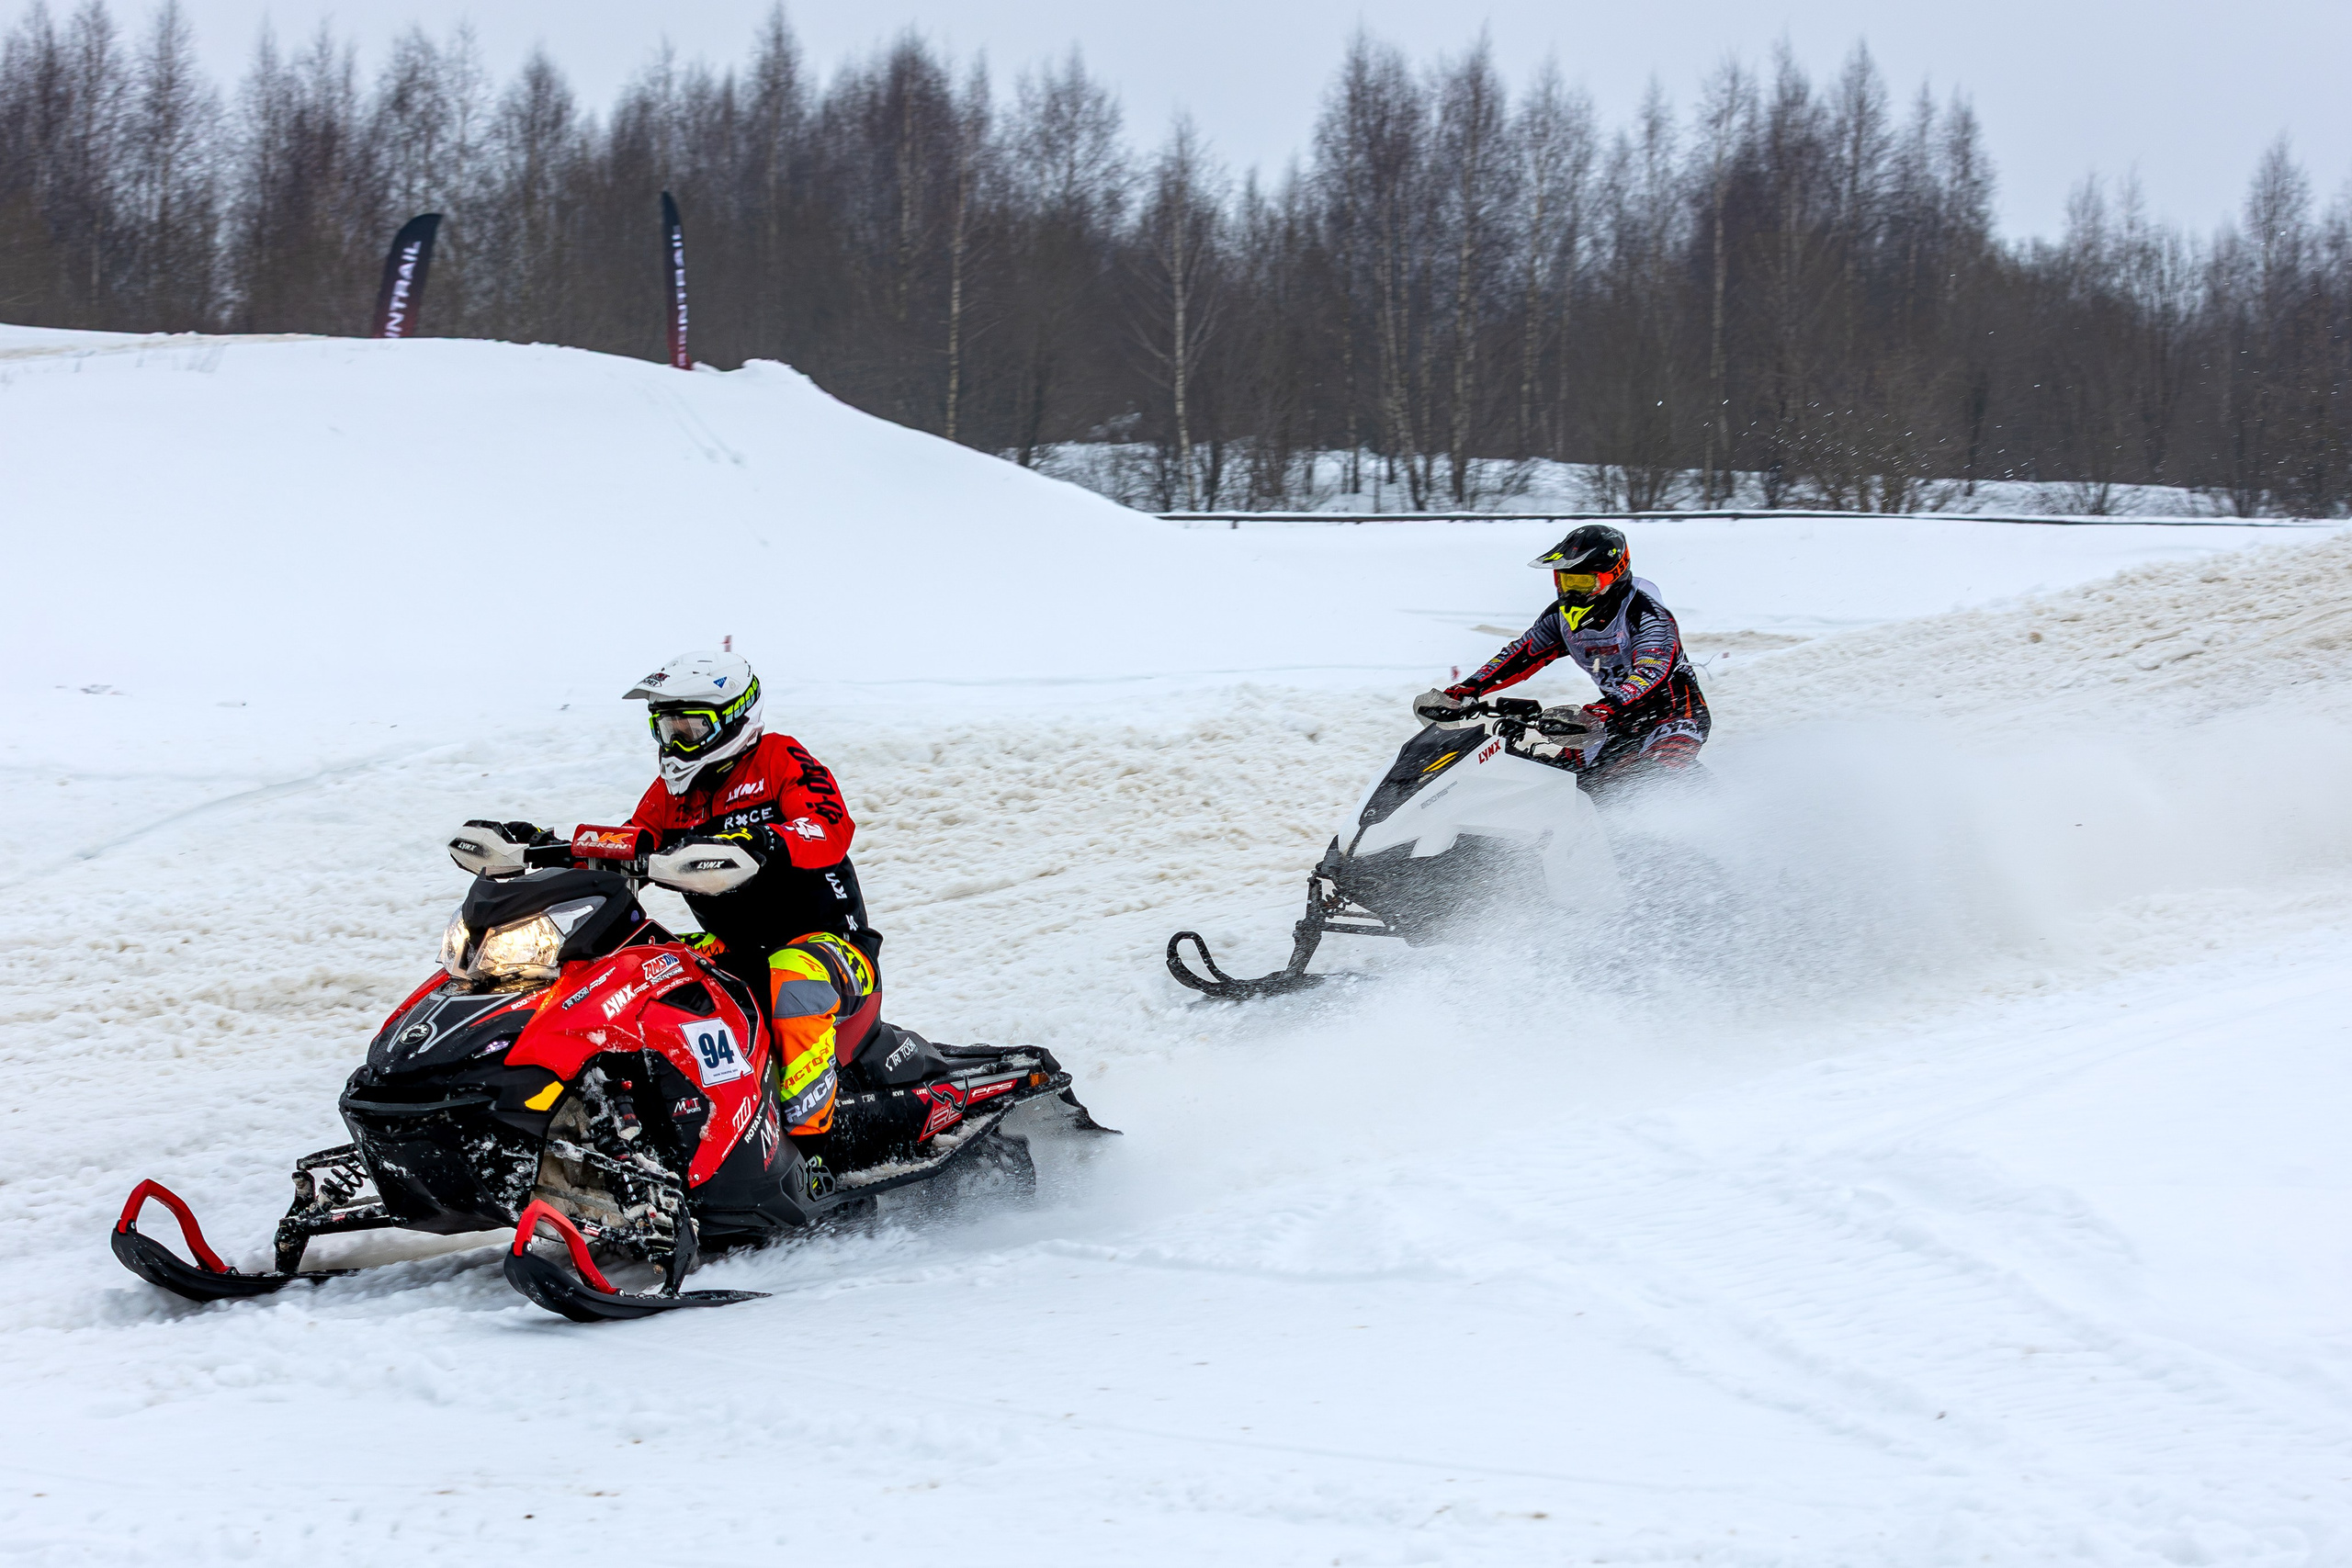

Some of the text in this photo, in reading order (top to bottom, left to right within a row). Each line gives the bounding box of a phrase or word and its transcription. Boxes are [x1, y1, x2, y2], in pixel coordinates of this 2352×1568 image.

[1477, 739, 1502, 764] LYNX
[457, 840, 478, 852] LYNX
[696, 860, 725, 870] LYNX
[644, 953, 679, 980] AMSOIL
[601, 982, 636, 1020] LYNX
[697, 1029, 735, 1069] 94
[785, 1070, 837, 1124] RACE
[971, 1081, 1013, 1098] PPS
[743, 1114, 763, 1144] ROTAX
